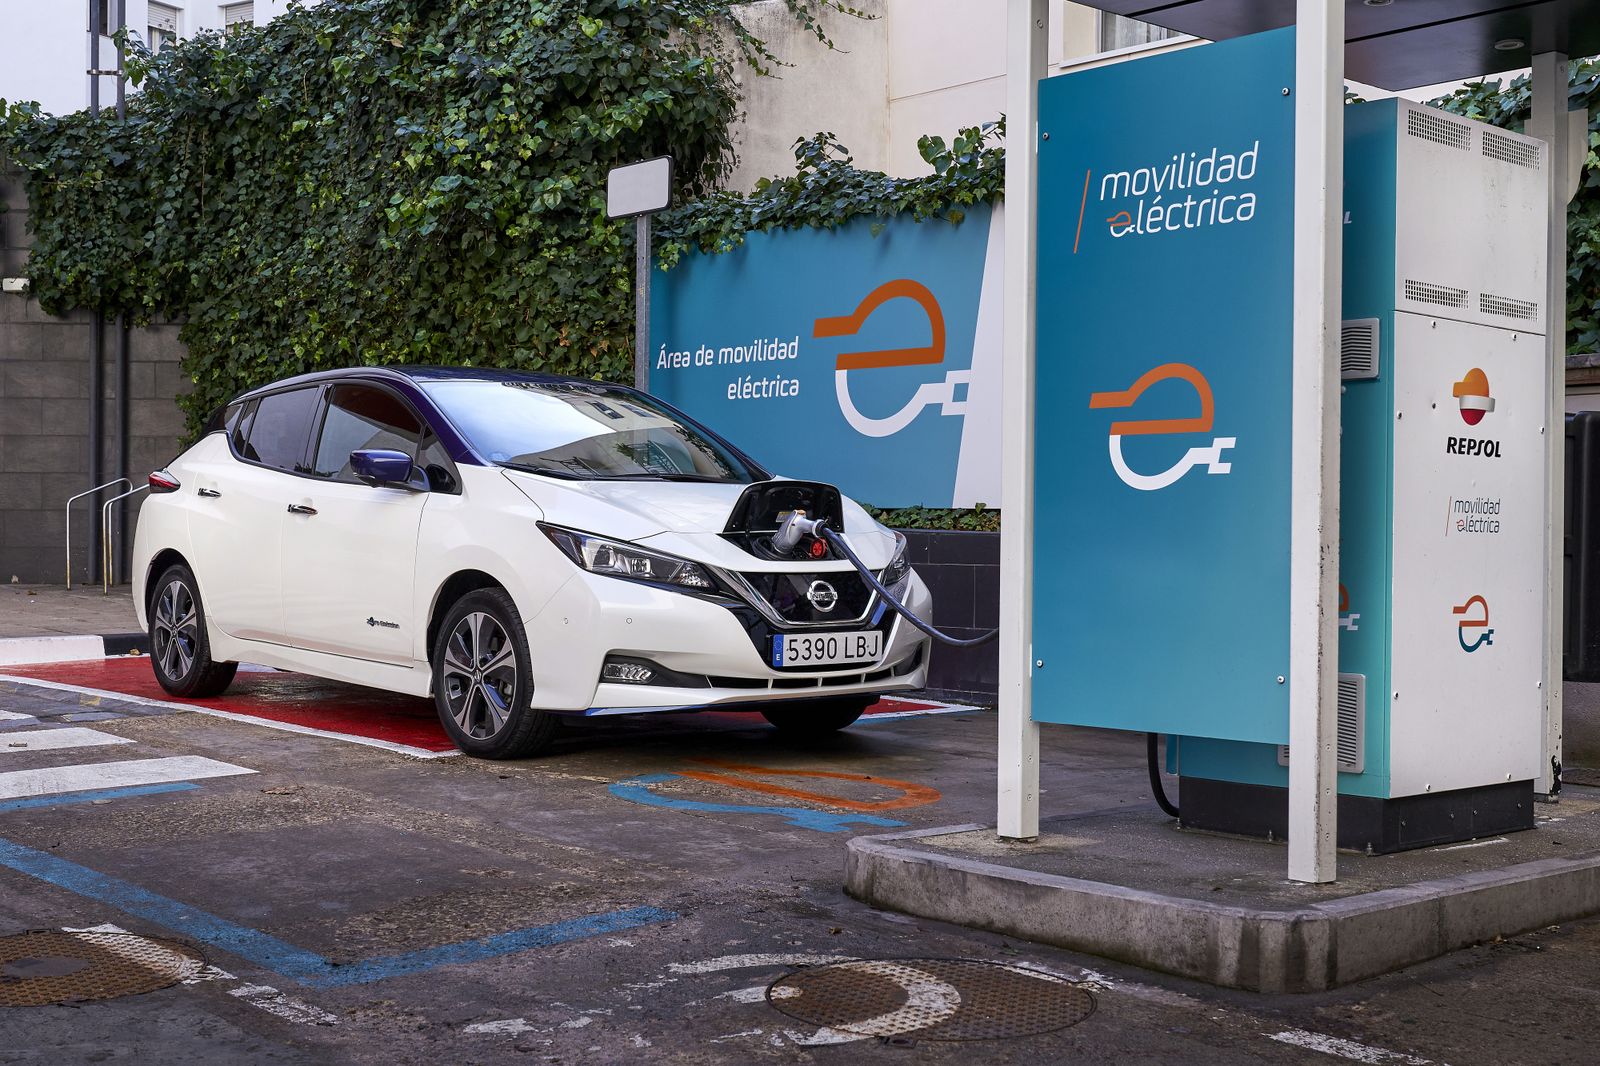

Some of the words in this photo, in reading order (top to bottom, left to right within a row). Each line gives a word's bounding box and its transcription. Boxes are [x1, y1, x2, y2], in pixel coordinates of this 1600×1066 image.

[1100, 140, 1259, 201] movilidad
[1107, 190, 1257, 237] eléctrica
[656, 343, 690, 369] Área
[695, 344, 714, 367] de
[718, 336, 799, 364] movilidad
[727, 375, 799, 400] eléctrica
[1446, 436, 1501, 458] REPSOL
[1453, 497, 1501, 515] movilidad
[788, 637, 837, 661] 5390
[844, 635, 879, 659] LBJ
